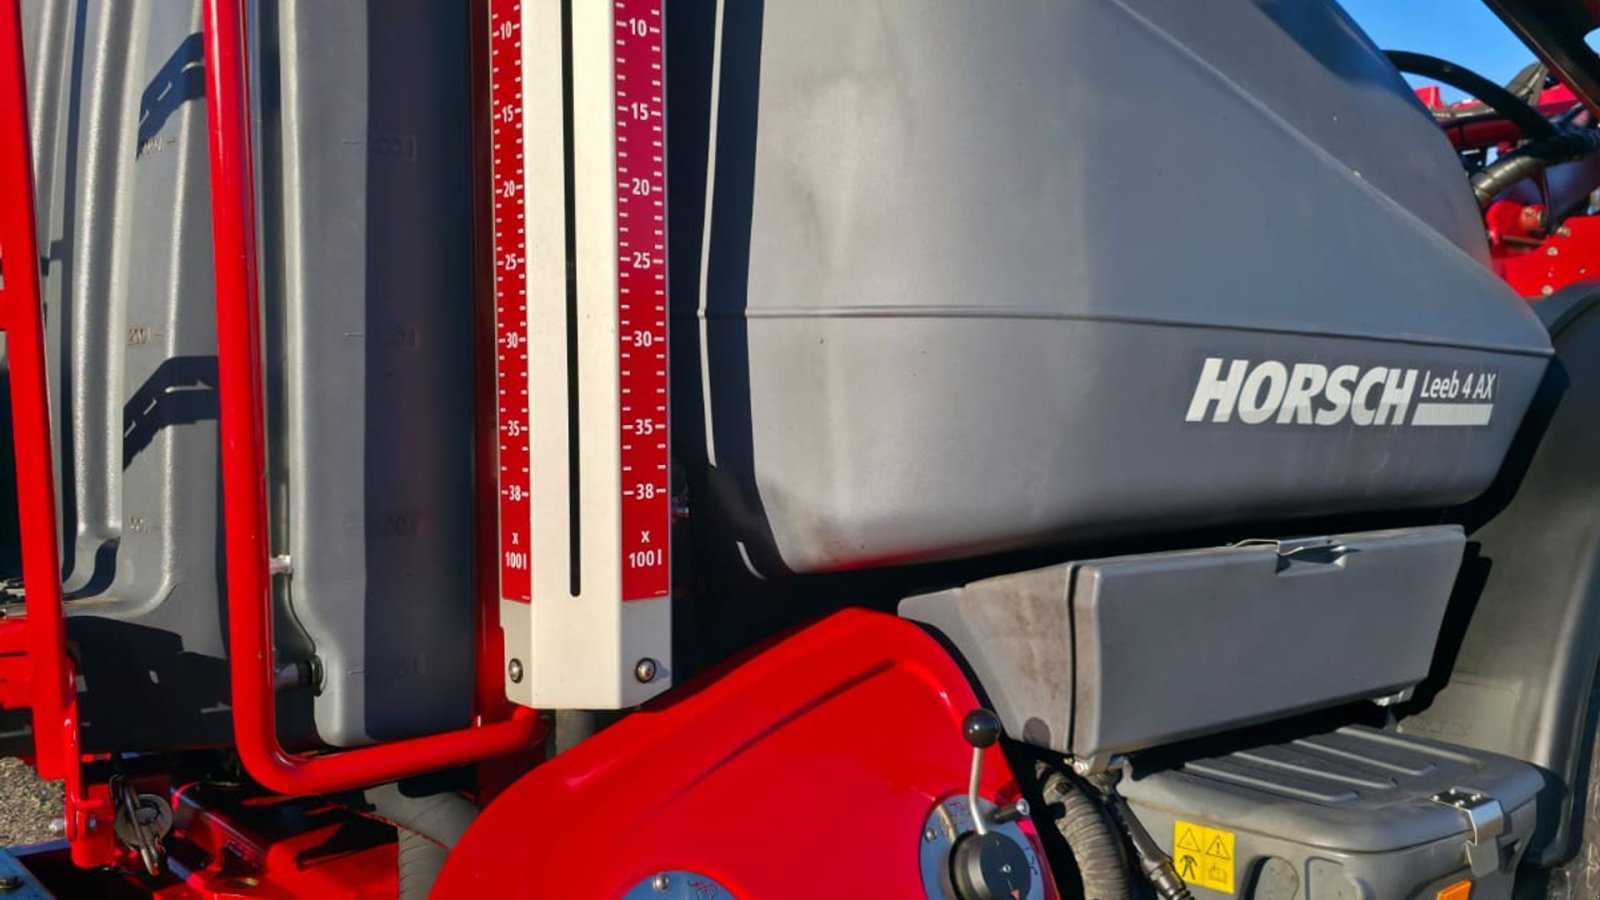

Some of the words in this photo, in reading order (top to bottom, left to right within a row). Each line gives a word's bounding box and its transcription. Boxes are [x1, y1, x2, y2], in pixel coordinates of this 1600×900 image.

[500, 22, 513, 40] 10
[630, 18, 647, 36] 10
[502, 105, 513, 122] 15
[632, 102, 648, 120] 15
[504, 180, 516, 197] 20
[632, 178, 649, 195] 20
[506, 253, 518, 270] 25
[634, 252, 650, 269] 25
[507, 332, 518, 348] 30
[634, 331, 652, 347] 30
[1185, 358, 1418, 426] HORSCH
[1421, 370, 1459, 398] Leeb
[1461, 372, 1472, 399] 4
[1474, 372, 1497, 399] AX
[508, 420, 519, 436] 35
[636, 419, 652, 434] 35
[510, 485, 522, 501] 38
[637, 483, 653, 499] 38
